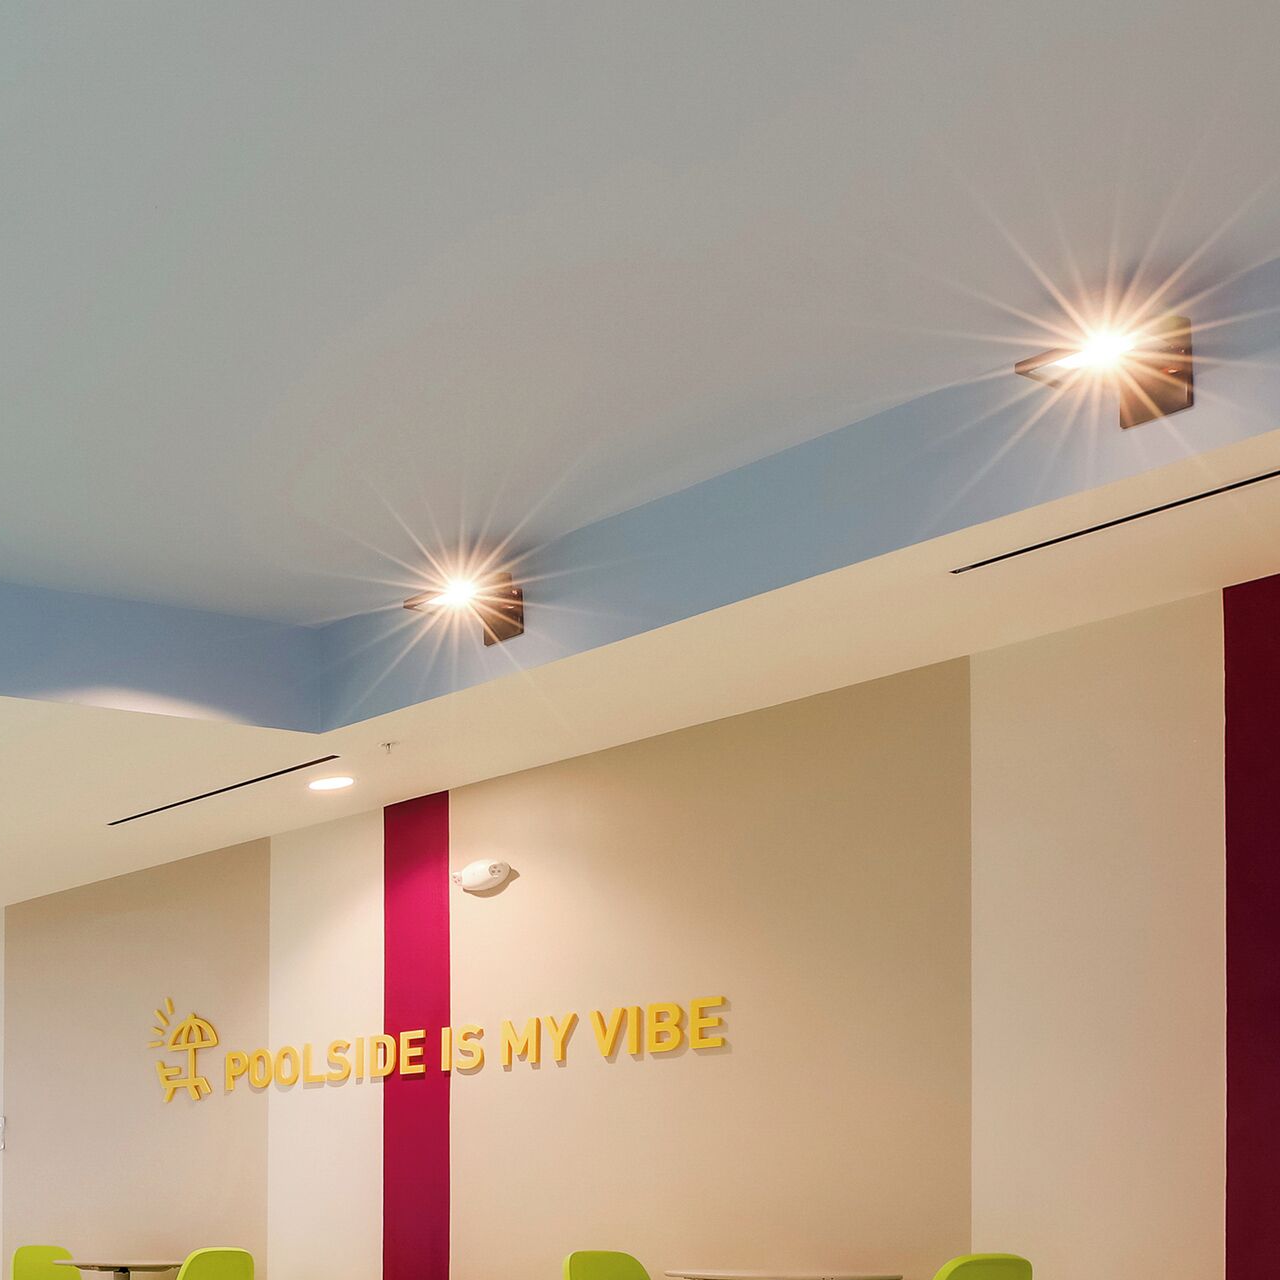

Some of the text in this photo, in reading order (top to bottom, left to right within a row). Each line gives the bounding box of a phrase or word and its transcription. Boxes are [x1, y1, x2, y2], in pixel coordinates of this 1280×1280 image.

[225, 996, 727, 1092] POOLSIDE IS MY VIBE
